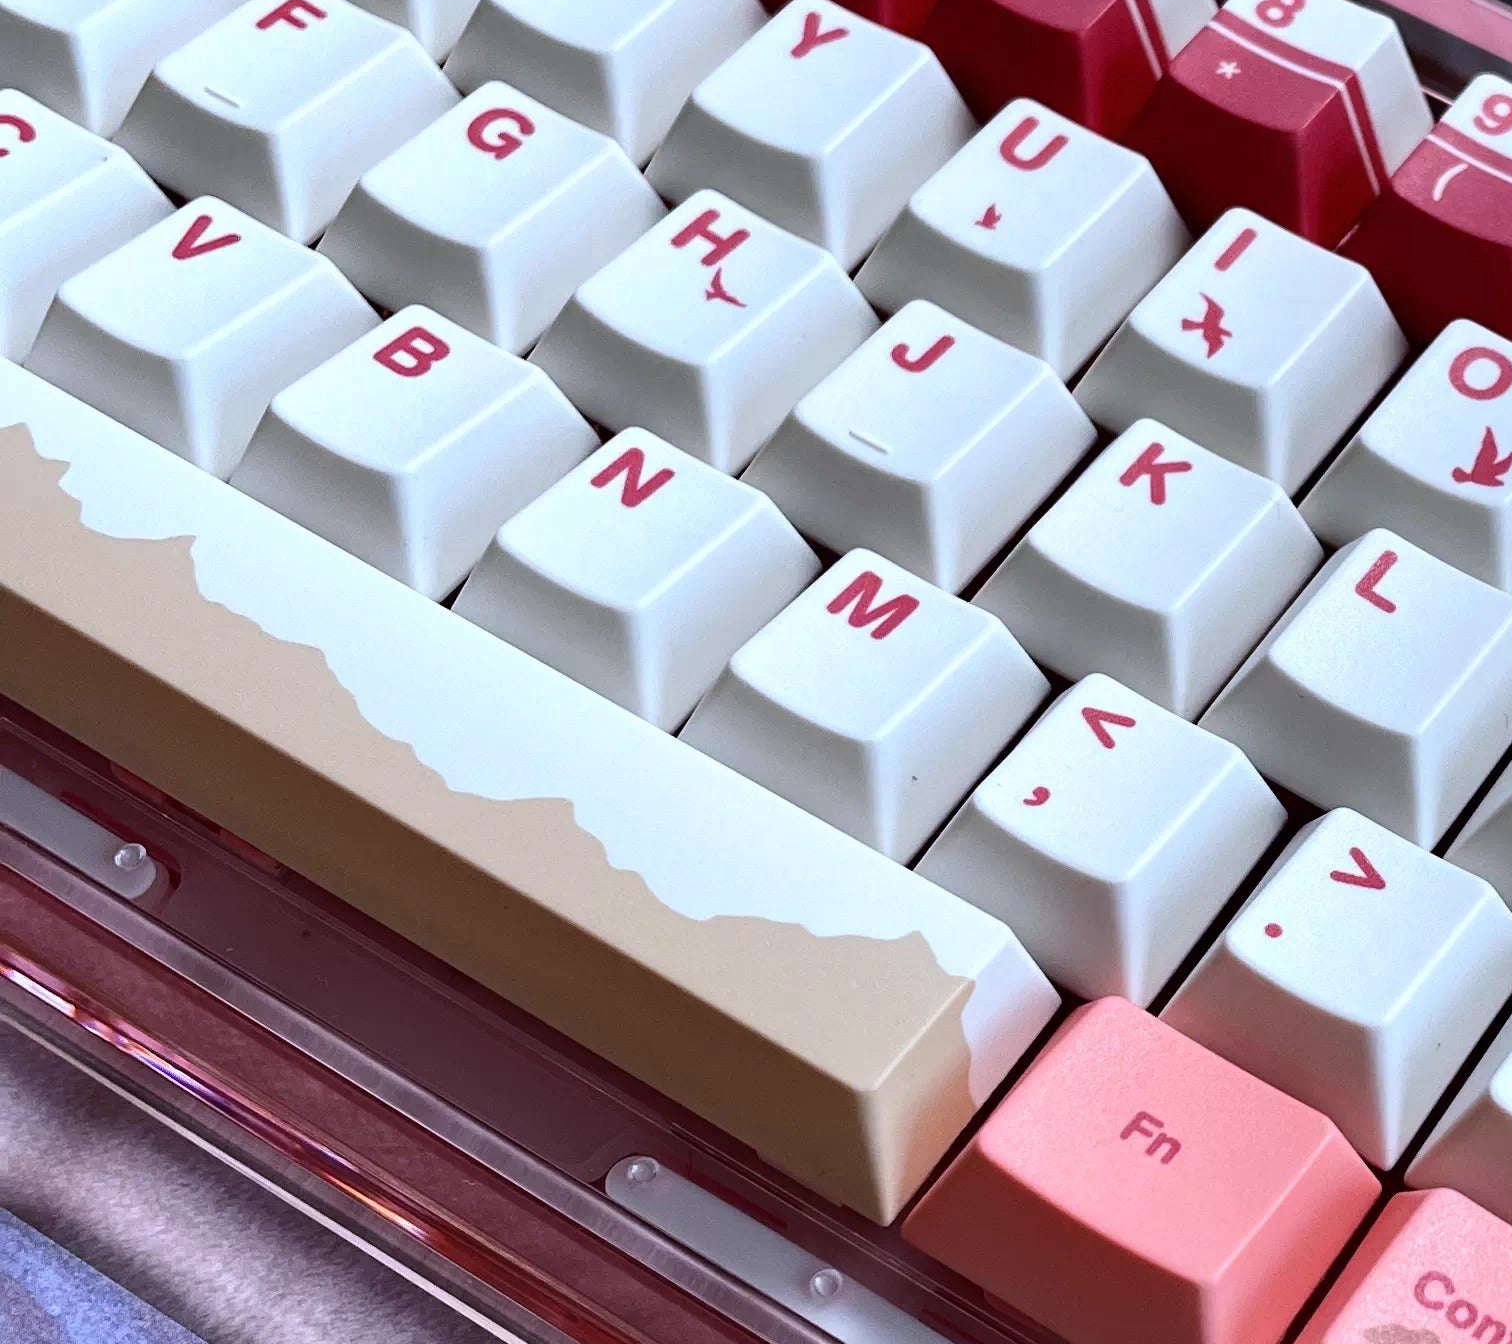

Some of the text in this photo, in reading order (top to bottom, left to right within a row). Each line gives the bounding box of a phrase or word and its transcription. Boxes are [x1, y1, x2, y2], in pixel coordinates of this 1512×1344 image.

[790, 12, 850, 58] Y
[467, 108, 534, 159] G
[999, 116, 1068, 171] U
[1433, 163, 1468, 200] (
[172, 216, 239, 259] V
[671, 210, 748, 266] H
[374, 327, 450, 377] B
[891, 336, 954, 372] J
[592, 448, 673, 507] N
[1120, 443, 1191, 505] K
[827, 572, 919, 639] M
[1355, 551, 1397, 613] L
[1082, 708, 1135, 748] <
[1331, 848, 1385, 890] >
[1120, 1112, 1181, 1164] Fn
